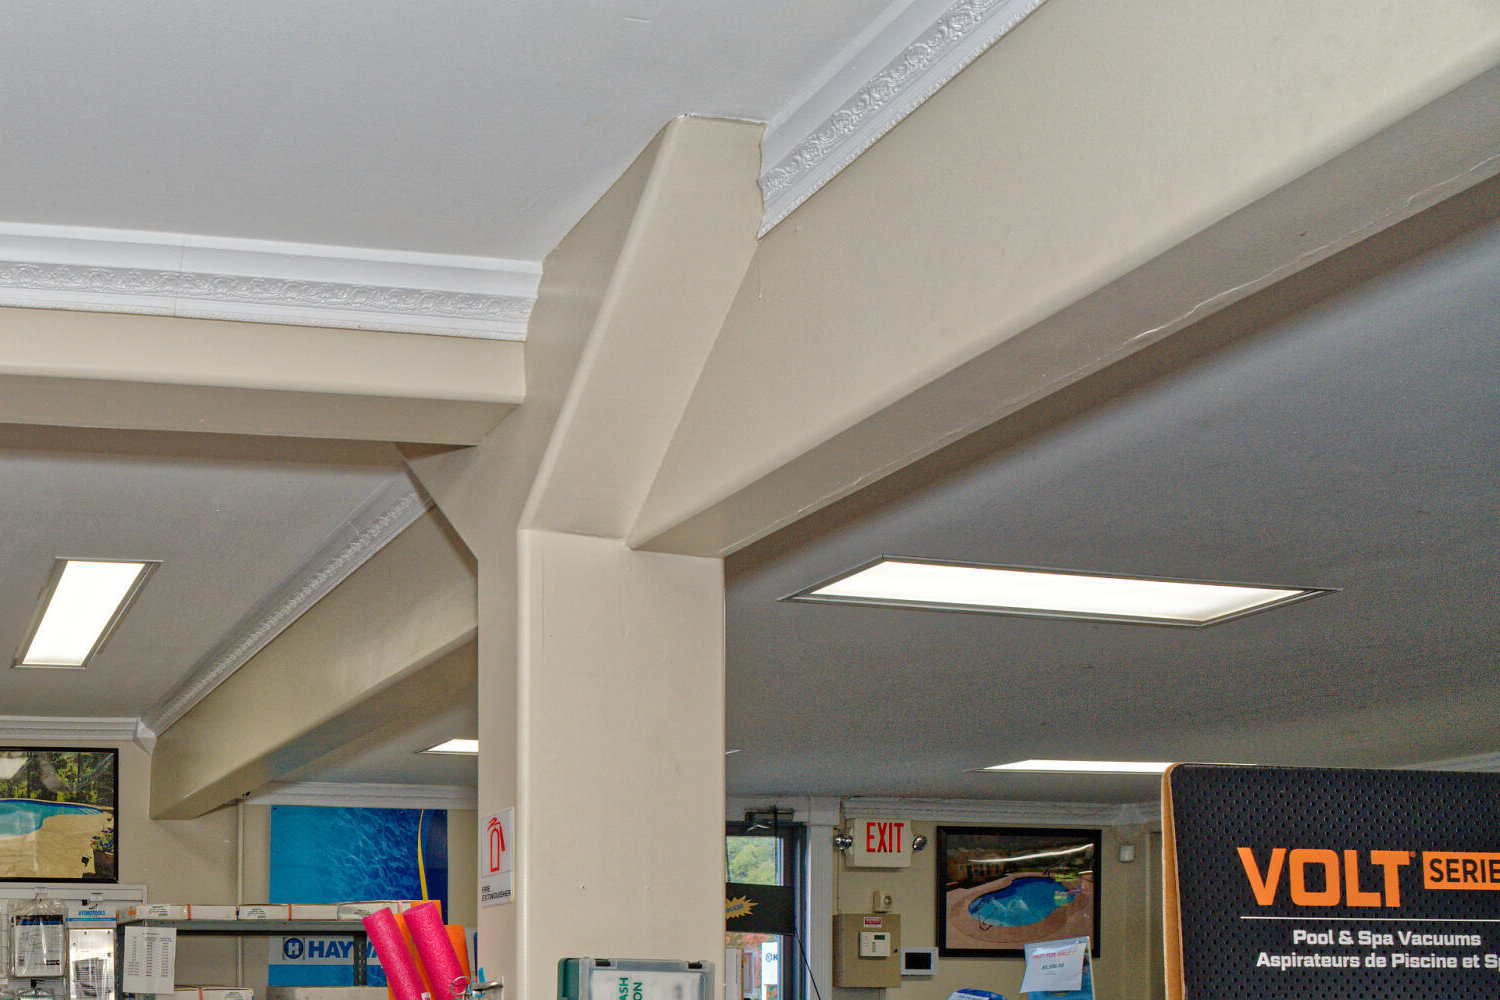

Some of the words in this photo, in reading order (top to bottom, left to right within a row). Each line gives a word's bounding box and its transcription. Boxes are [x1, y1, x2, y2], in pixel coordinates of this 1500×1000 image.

[866, 822, 904, 853] EXIT
[1236, 846, 1411, 908] VOLT
[1429, 858, 1500, 884] SERIE
[482, 885, 490, 893] FIRE
[482, 890, 512, 902] EXTINGUISHER
[1293, 930, 1334, 946] Pool
[1338, 930, 1355, 946] &
[1358, 930, 1394, 950] Spa
[1398, 932, 1482, 947] Vacuums
[1256, 952, 1362, 971] Aspirateurs
[1364, 954, 1387, 969] de
[1392, 954, 1458, 970] Piscine
[1462, 956, 1480, 970] et
